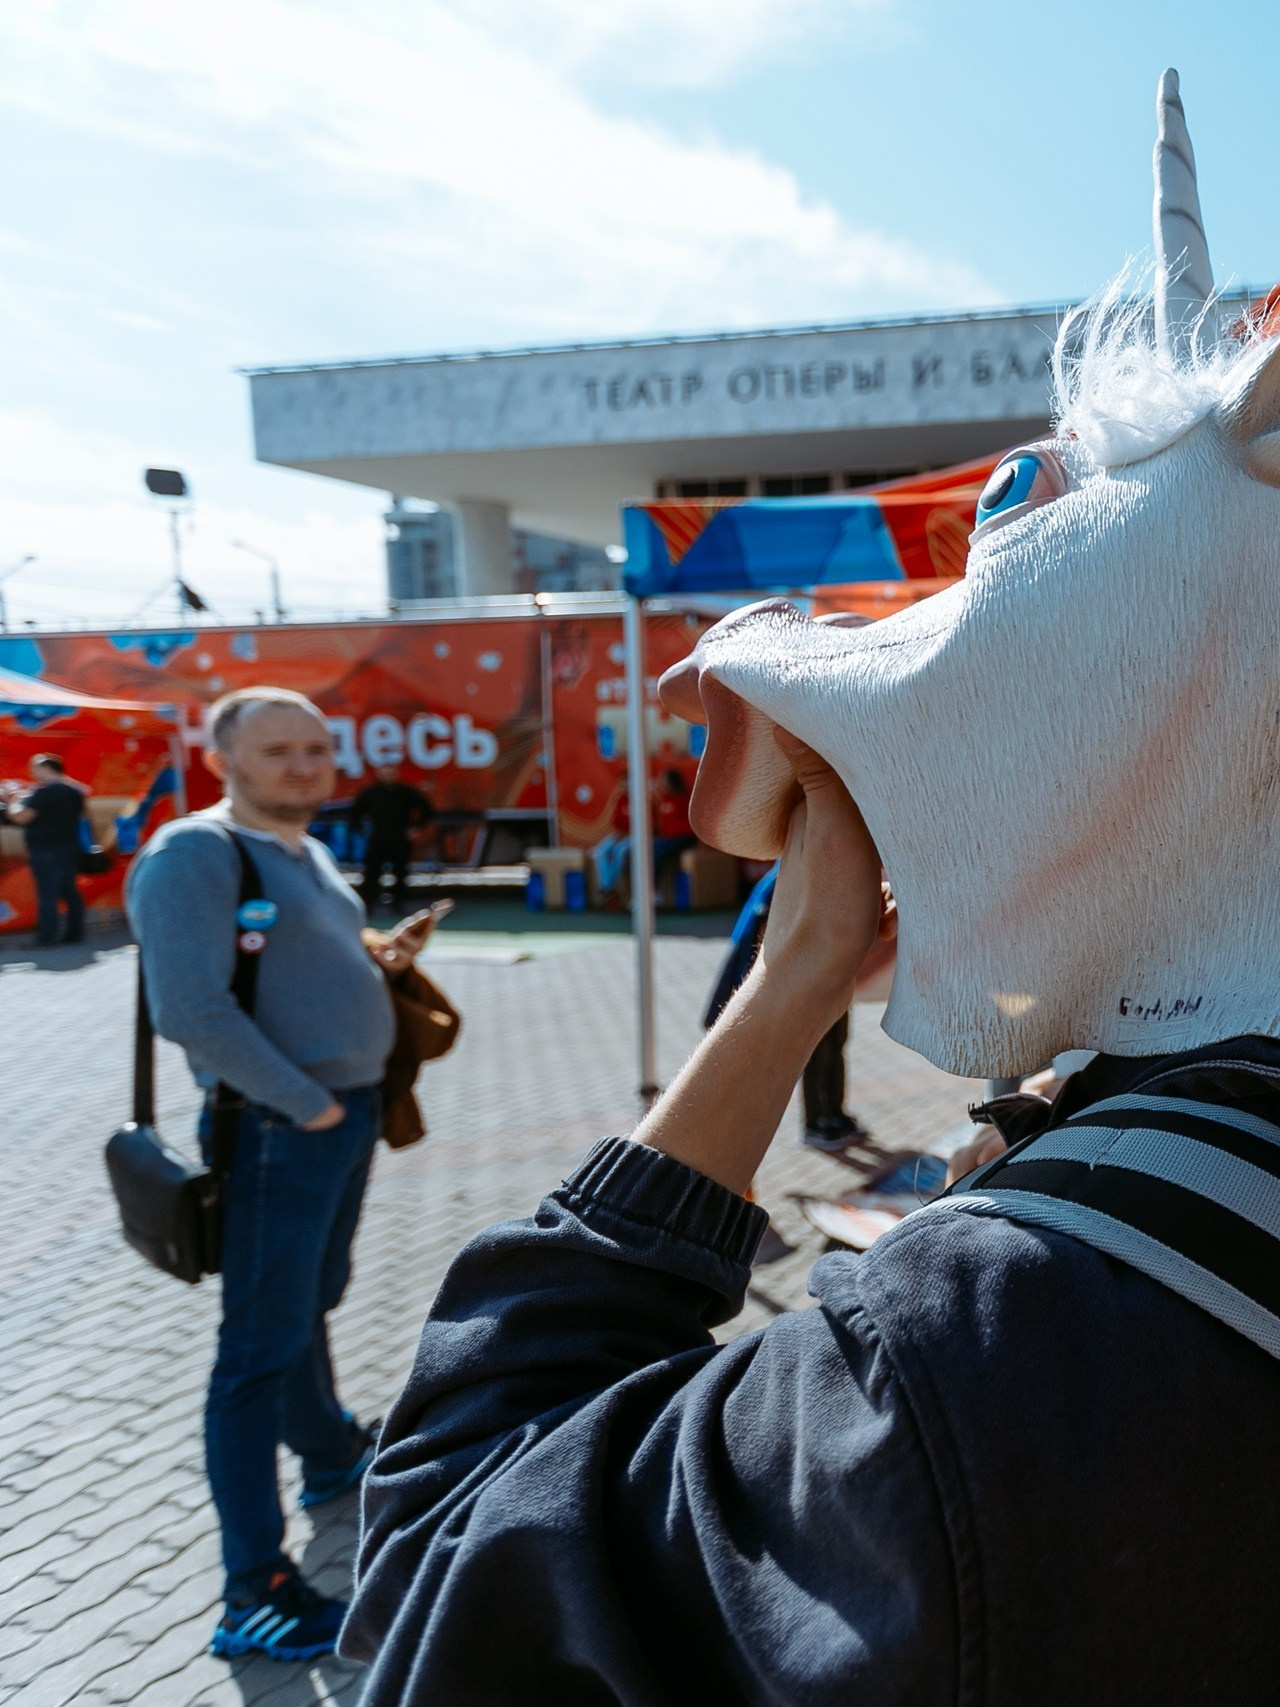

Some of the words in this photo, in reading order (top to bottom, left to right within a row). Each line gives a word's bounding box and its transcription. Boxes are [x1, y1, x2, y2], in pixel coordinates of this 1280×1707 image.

[583, 372, 702, 412] ТЕАТР
[727, 357, 885, 404] ОПЕРЫ
[911, 353, 944, 388] И
[327, 713, 499, 779] десь
